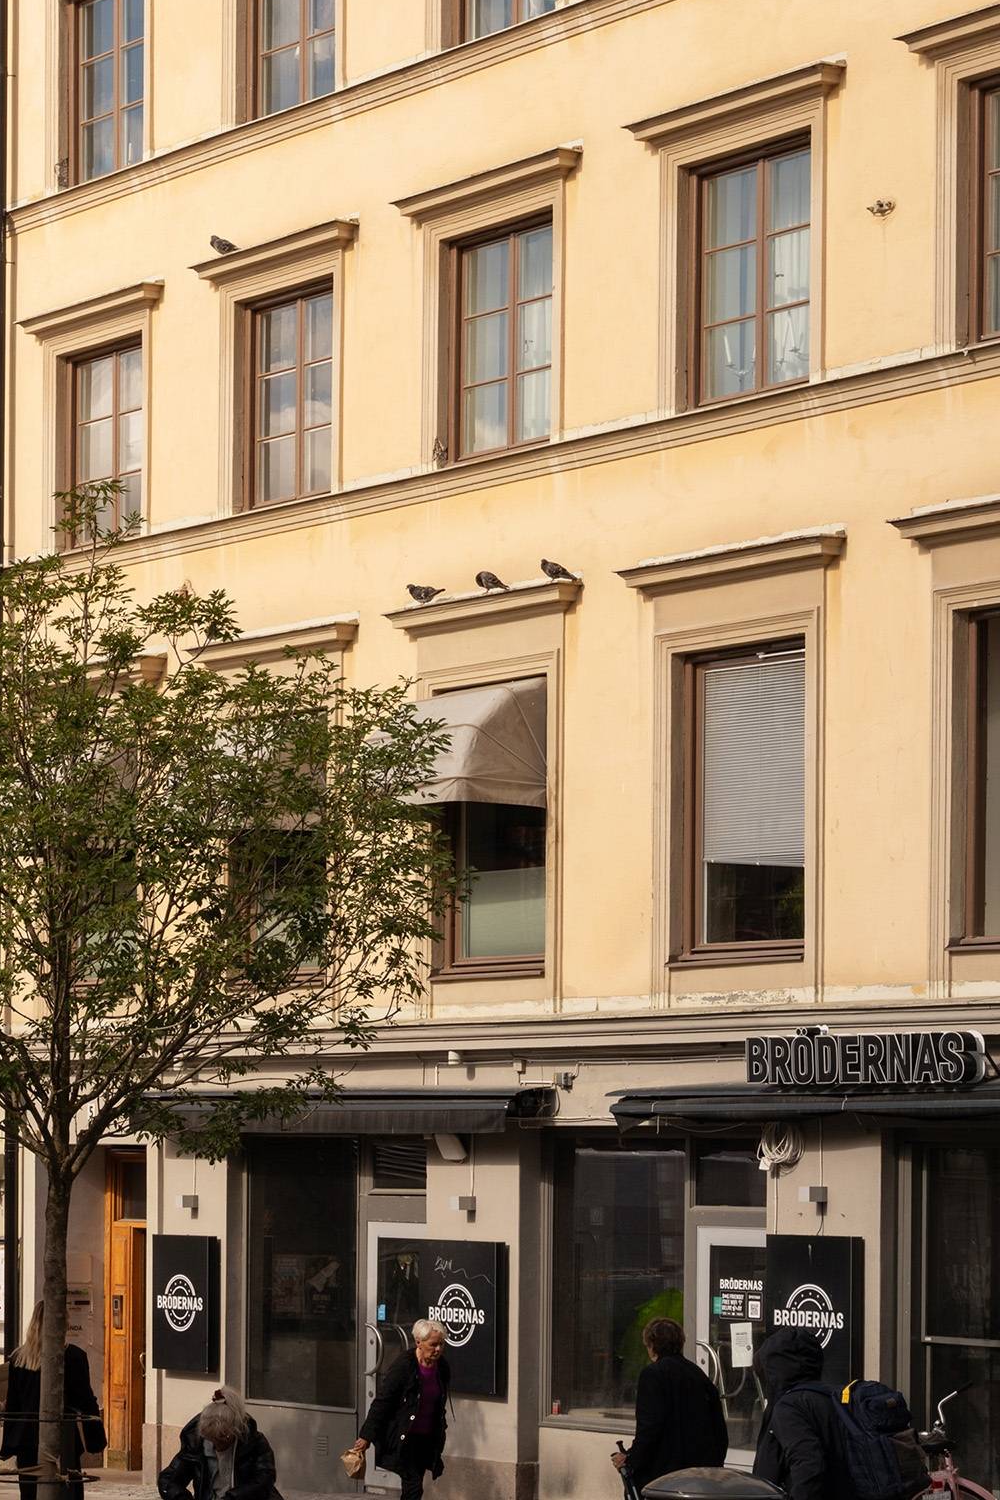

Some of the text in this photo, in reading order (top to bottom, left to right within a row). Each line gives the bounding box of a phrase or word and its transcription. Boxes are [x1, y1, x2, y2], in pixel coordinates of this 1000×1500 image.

[745, 1027, 965, 1084] BRÖDERNAS
[719, 1277, 763, 1291] BRÖDERNAS
[157, 1293, 203, 1311] BRÖDERNAS
[428, 1304, 485, 1324] BRÖDERNAS
[773, 1307, 844, 1329] BRÖDERNAS
